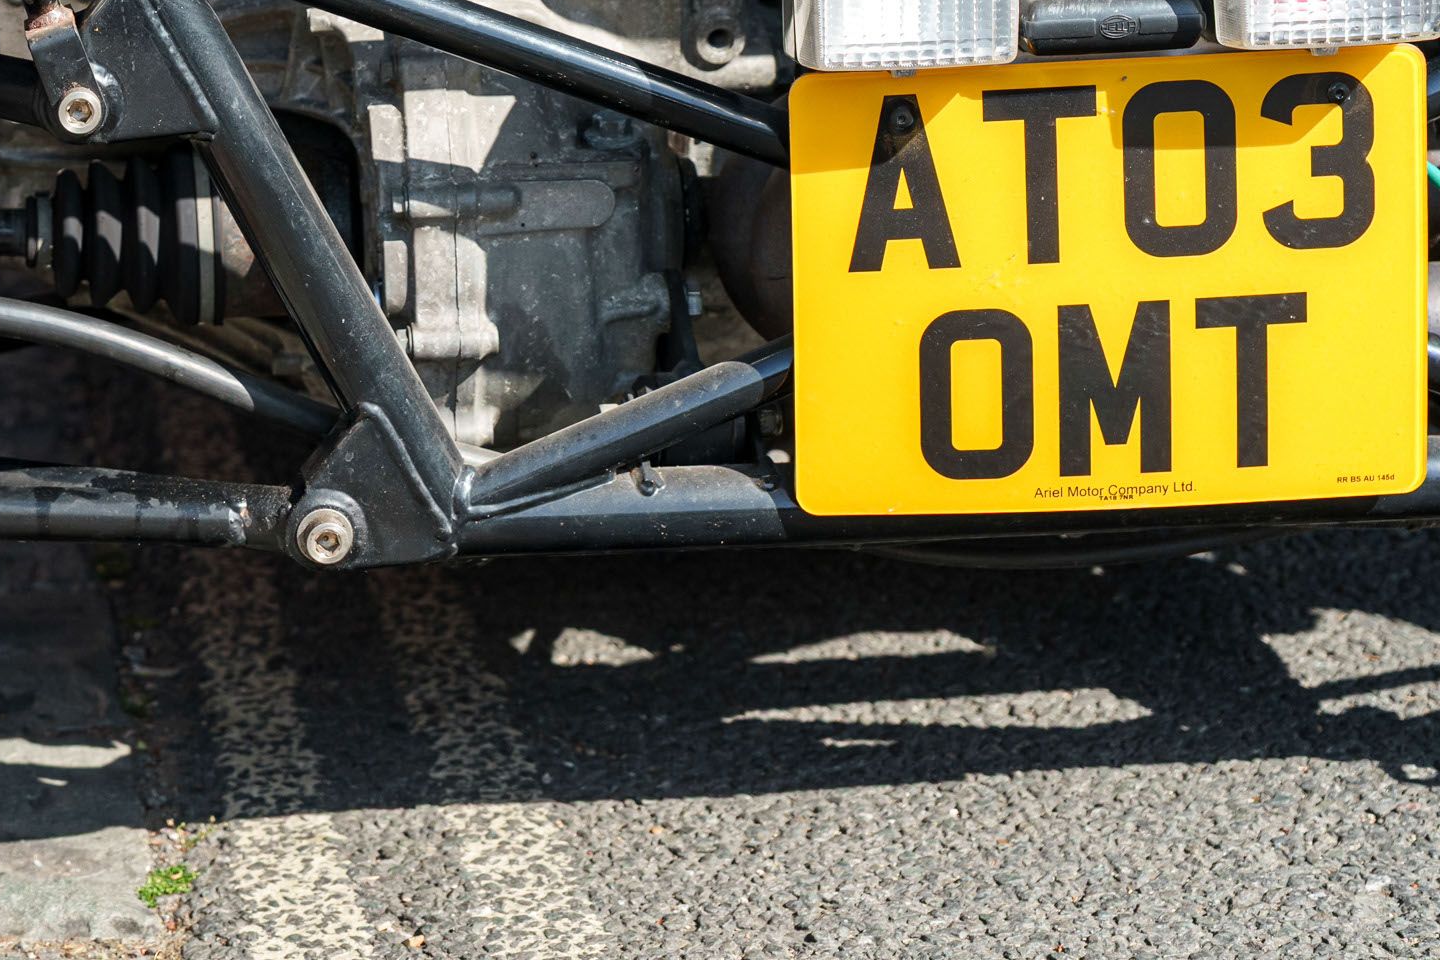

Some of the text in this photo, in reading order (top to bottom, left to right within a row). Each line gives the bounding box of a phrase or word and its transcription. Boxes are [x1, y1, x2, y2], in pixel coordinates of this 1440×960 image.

[918, 291, 1308, 480] OMT
[1363, 474, 1375, 482] AU
[1034, 481, 1197, 498] Ariel Motor Company Ltd.
